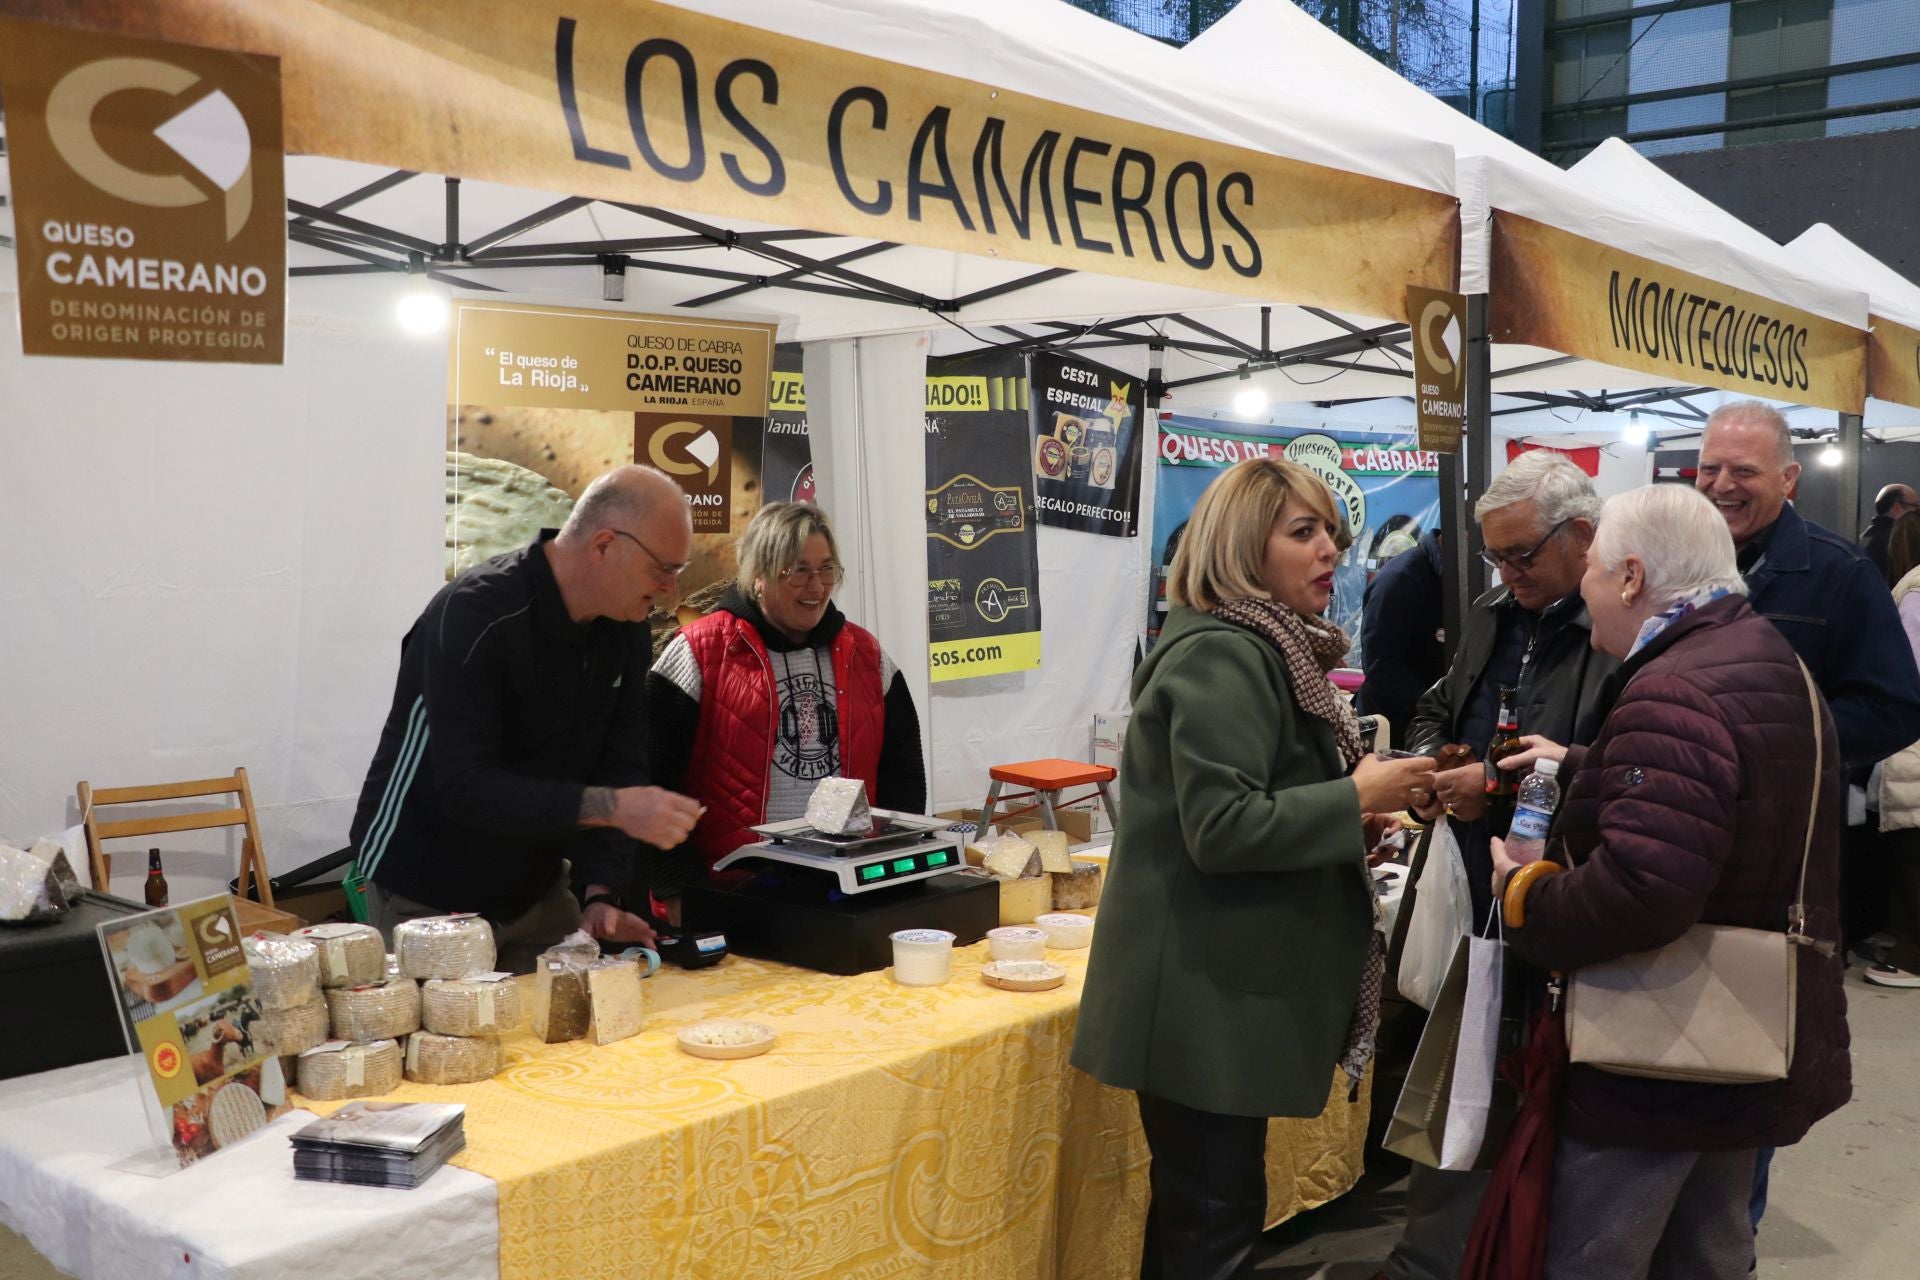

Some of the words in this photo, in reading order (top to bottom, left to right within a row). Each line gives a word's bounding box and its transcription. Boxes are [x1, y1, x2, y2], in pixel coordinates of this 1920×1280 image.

[555, 17, 787, 196] LOS
[827, 86, 1263, 278] CAMEROS
[43, 220, 134, 248] QUESO
[46, 252, 267, 297] CAMERANO
[51, 300, 231, 326] DENOMINACIÓN
[240, 311, 266, 328] DE
[51, 323, 140, 343] ORIGEN
[149, 328, 266, 349] PROTEGIDA
[1608, 270, 1809, 392] MONTEQUESOS
[627, 334, 674, 351] QUESO
[677, 337, 697, 352] DE
[698, 339, 743, 355] CABRA
[516, 354, 558, 370] queso
[561, 355, 578, 369] de
[627, 353, 679, 371] D.O.P.
[682, 356, 742, 375] QUESO
[500, 367, 523, 386] La
[626, 372, 742, 396] CAMERANO
[1061, 365, 1099, 388] CESTA
[1047, 386, 1104, 413] ESPECIAL
[1421, 383, 1439, 396] QUESO
[644, 396, 656, 405] LA
[659, 396, 688, 406] RIOJA
[691, 397, 725, 407] ESPAÑA
[1422, 399, 1462, 418] CAMERANO
[1161, 433, 1239, 465] QUESO
[1243, 441, 1269, 459] DE
[1353, 448, 1438, 471] CABRALES
[1289, 441, 1339, 464] Quesería
[711, 510, 722, 518] DE
[1036, 496, 1075, 514] REGALO
[1076, 503, 1131, 523] PERFECTO!!
[930, 645, 1002, 667] sos.com
